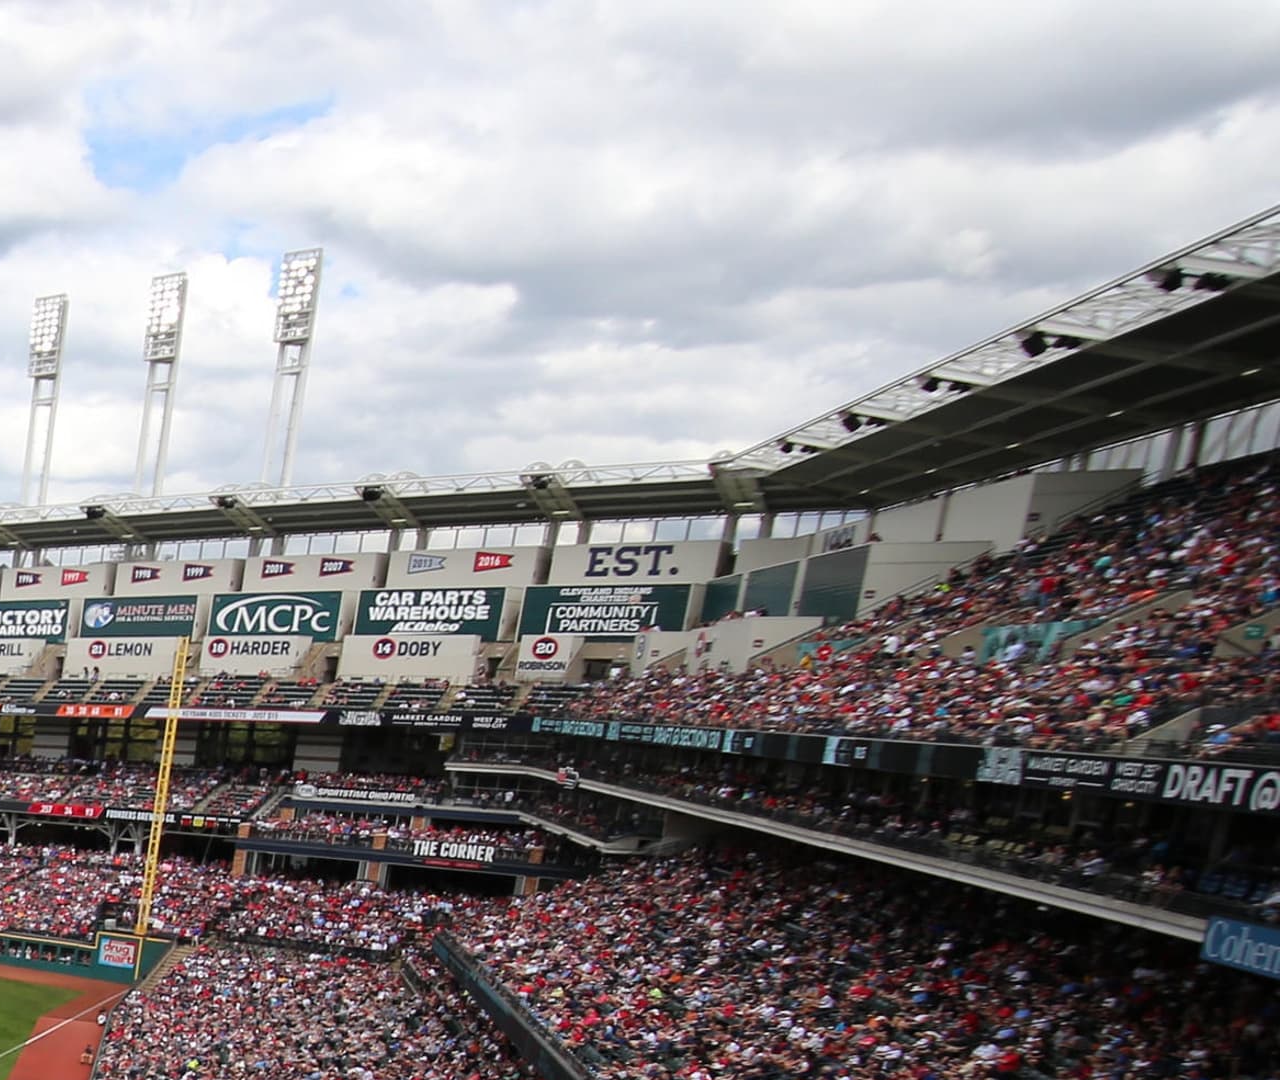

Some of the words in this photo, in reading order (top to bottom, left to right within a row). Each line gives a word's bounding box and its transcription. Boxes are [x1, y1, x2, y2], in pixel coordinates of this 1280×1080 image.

[322, 561, 343, 573] 2007
[477, 555, 501, 567] 2016
[584, 545, 679, 578] EST.
[186, 567, 203, 577] 1999
[264, 563, 284, 574] 2001
[374, 590, 416, 605] CAR
[420, 590, 487, 605] PARTS
[560, 586, 612, 597] CLEVELAND
[613, 586, 653, 596] INDIANS
[580, 594, 628, 603] CHARITIES
[115, 605, 165, 616] MINUTE
[166, 604, 195, 614] MEN
[368, 605, 491, 621] WAREHOUSE
[555, 605, 650, 620] COMMUNITY
[26, 624, 62, 636] OHIO
[559, 619, 640, 633] PARTNERS
[91, 645, 103, 655] 21
[107, 643, 153, 656] LEMON
[230, 640, 290, 656] HARDER
[377, 642, 392, 656] 14
[397, 640, 442, 656] DOBY
[536, 641, 554, 655] 20
[518, 661, 566, 671] ROBINSON
[392, 713, 424, 722] MARKET
[427, 715, 462, 723] GARDEN
[1027, 757, 1065, 772] MARKET
[1065, 759, 1109, 776] GARDEN
[1115, 762, 1138, 778] WEST
[1110, 779, 1134, 791] OHIO
[1134, 780, 1159, 793] CITY
[1161, 764, 1253, 806] DRAFT
[1249, 772, 1280, 811] @
[318, 789, 368, 800] SPORTSTIME
[368, 791, 389, 801] OHIO
[389, 792, 415, 802] PATIO
[105, 808, 137, 820] FOUNDERS
[412, 840, 437, 857] THE
[440, 842, 495, 863] CORNER
[103, 943, 130, 957] drug
[103, 952, 133, 964] mart
